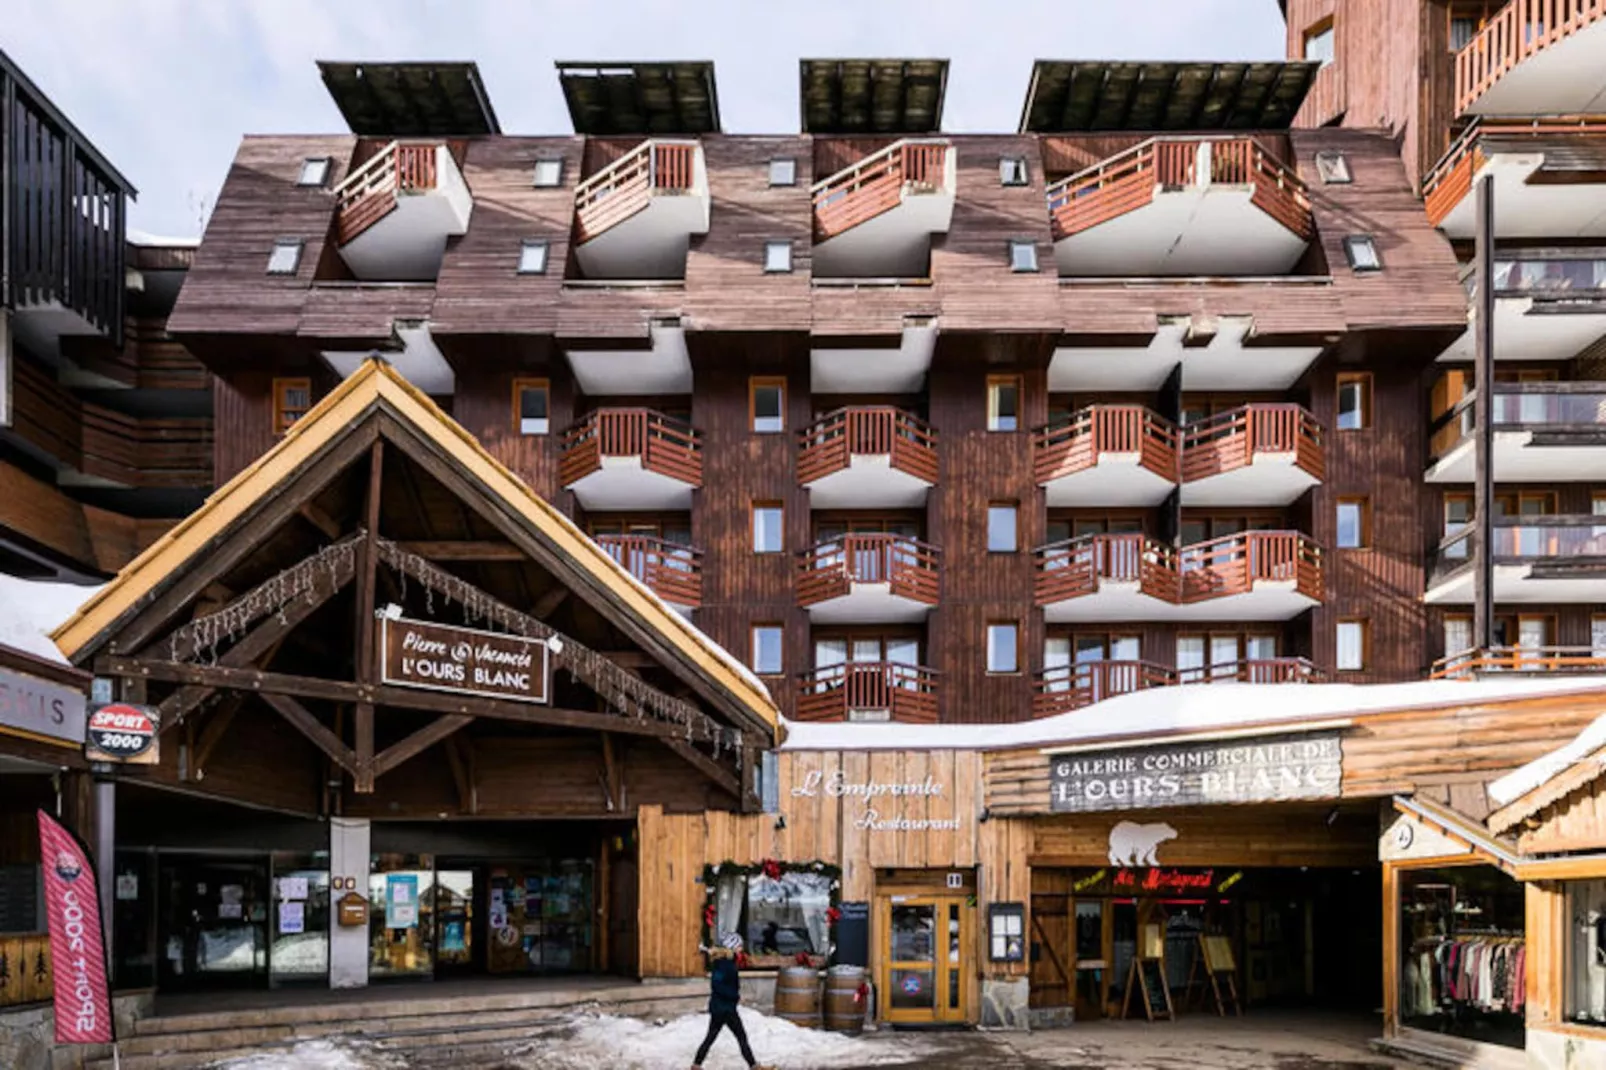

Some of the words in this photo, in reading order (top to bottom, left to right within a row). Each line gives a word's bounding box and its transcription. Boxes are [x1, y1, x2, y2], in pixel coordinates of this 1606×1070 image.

[402, 631, 447, 656] Pierre
[402, 657, 465, 681] L'OURS
[474, 667, 531, 690] BLANC
[94, 711, 146, 728] SPORT
[101, 732, 143, 749] 2000
[1057, 757, 1137, 776] GALERIE
[1143, 744, 1293, 770] COMMERCIALE
[1057, 775, 1180, 804] L'OURS
[1200, 766, 1332, 797] BLANC
[854, 809, 961, 831] Restaurant
